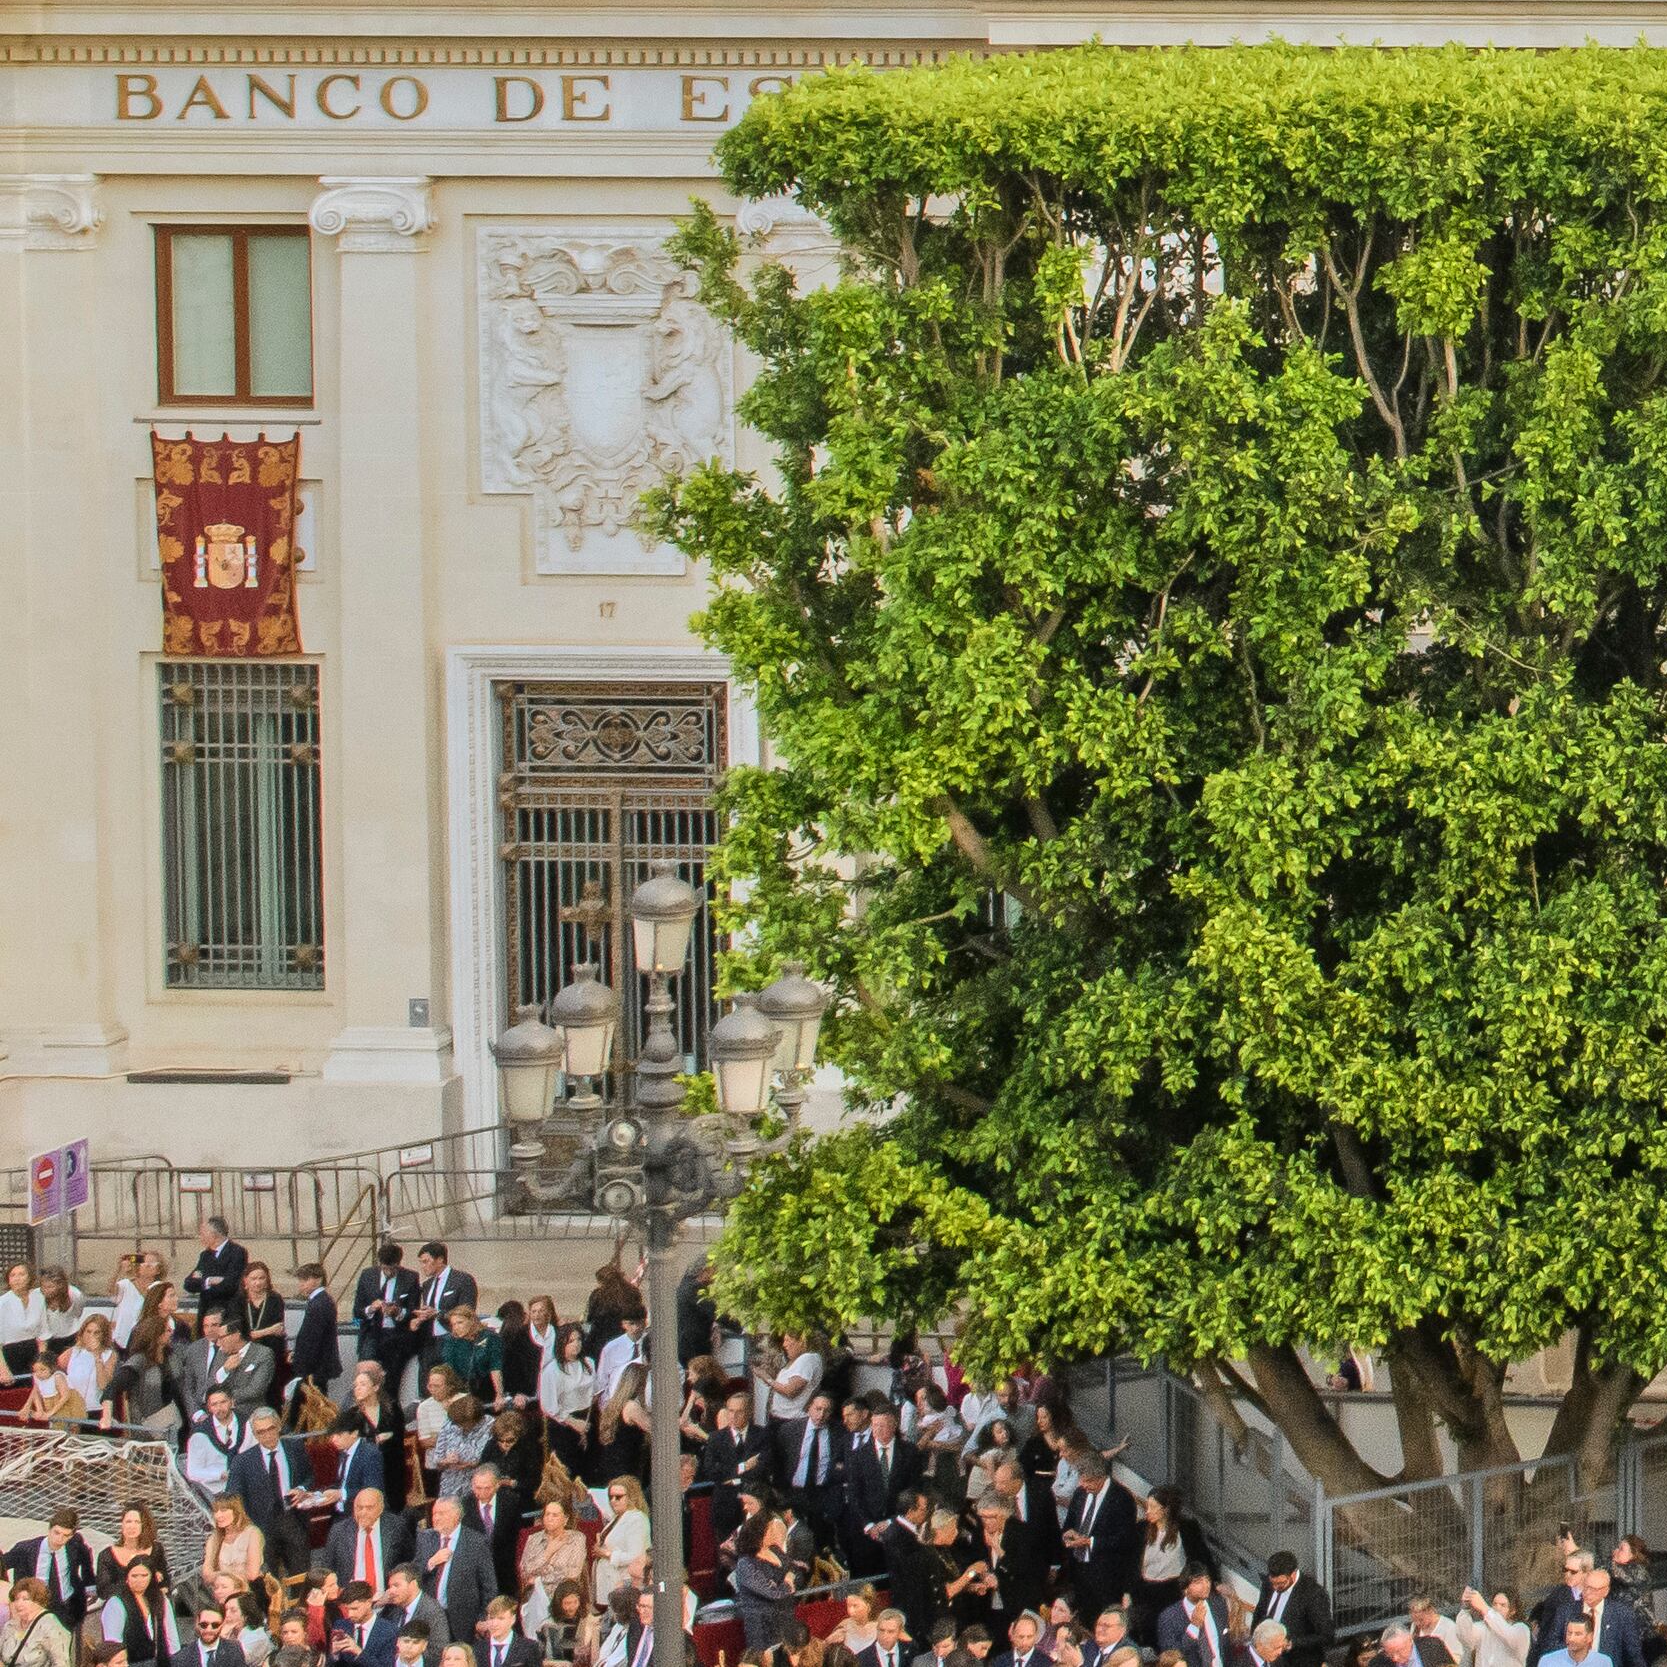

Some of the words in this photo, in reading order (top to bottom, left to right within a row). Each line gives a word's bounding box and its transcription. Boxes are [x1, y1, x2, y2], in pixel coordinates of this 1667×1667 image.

[114, 73, 430, 121] BANCO
[494, 74, 611, 123] DE
[599, 601, 617, 619] 17
